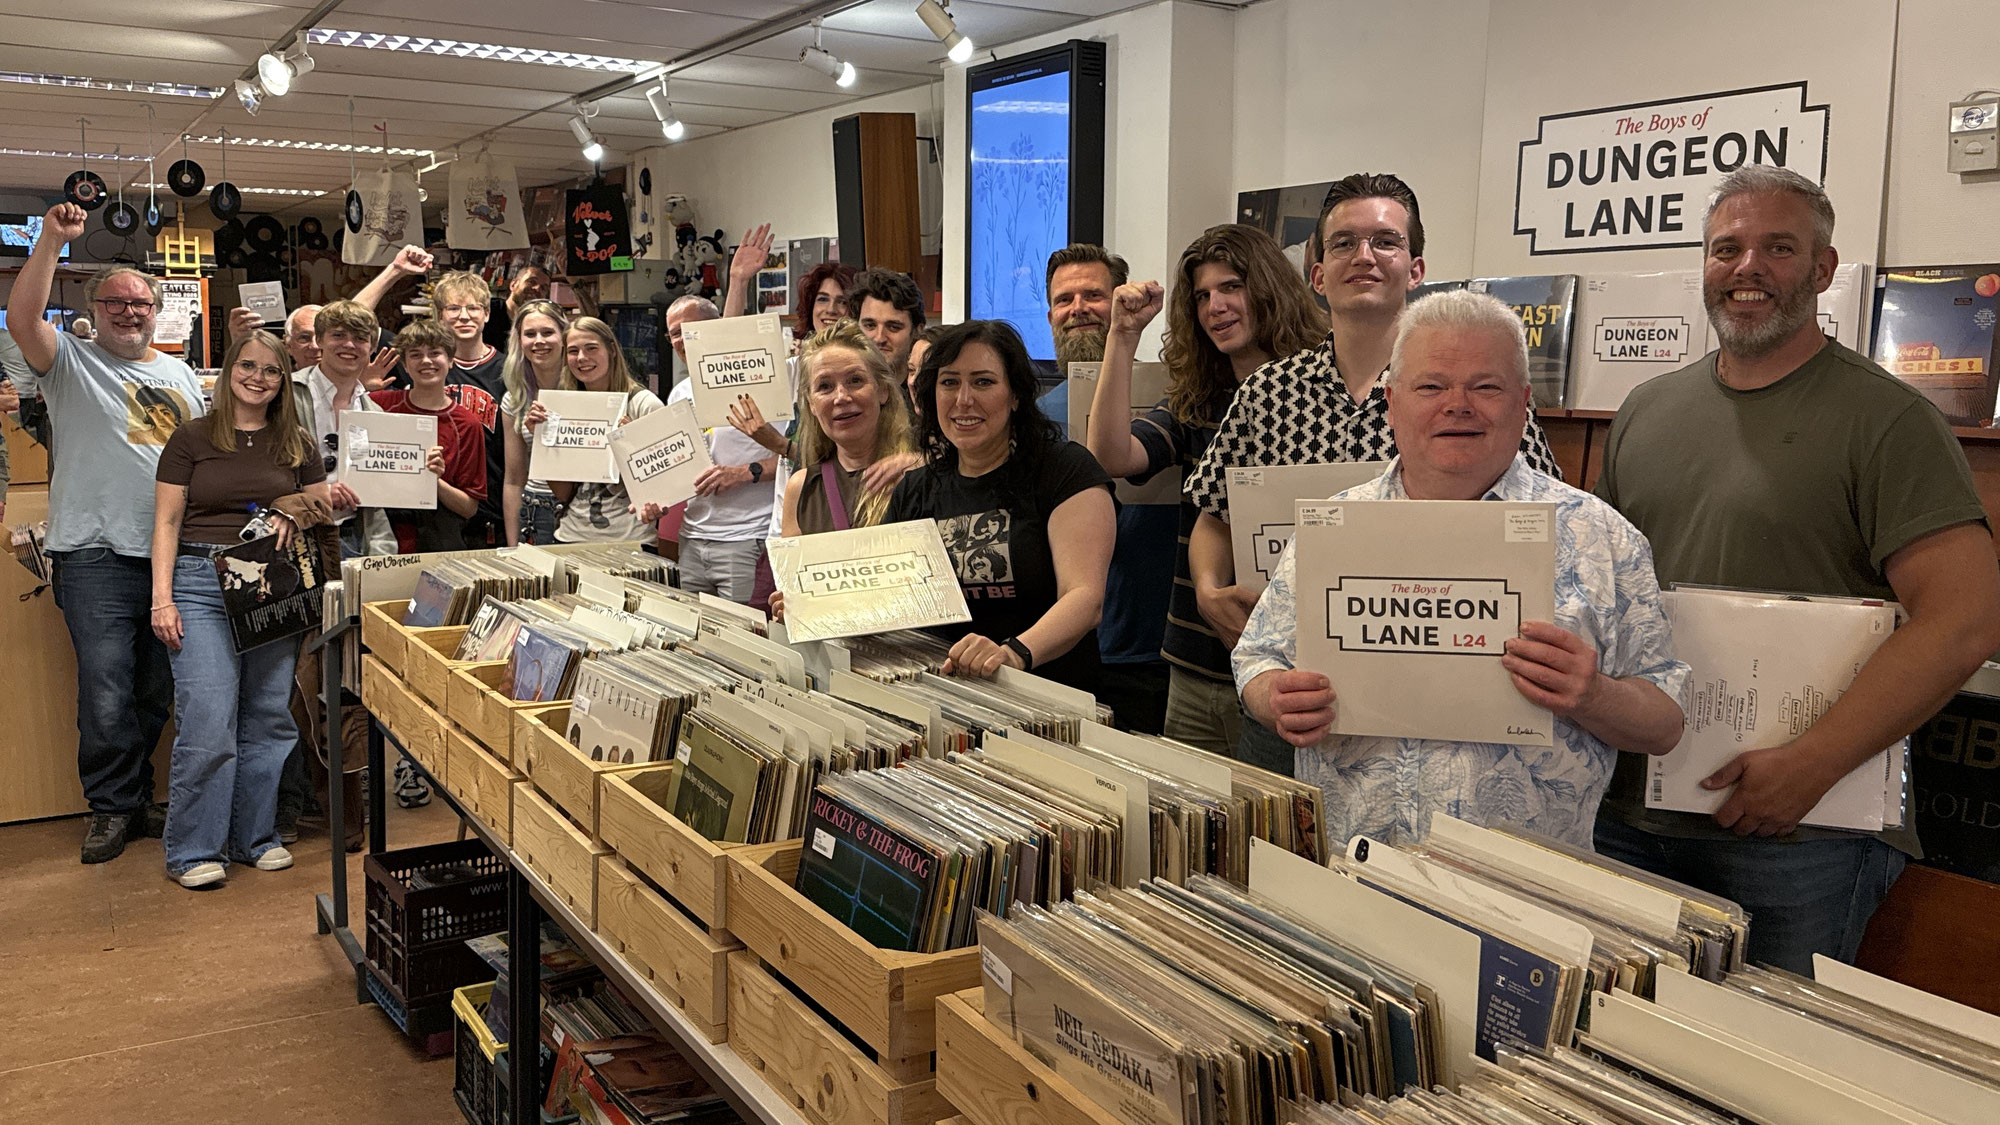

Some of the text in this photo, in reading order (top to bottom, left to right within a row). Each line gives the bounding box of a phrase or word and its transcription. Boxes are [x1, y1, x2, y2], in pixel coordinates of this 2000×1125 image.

[1615, 106, 1713, 136] The Boys of
[1547, 127, 1788, 189] DUNGEON
[1565, 193, 1683, 238] LANE
[162, 284, 198, 292] EATLES
[1604, 328, 1679, 342] DUNGEON
[1610, 345, 1671, 358] LANE L24
[707, 358, 766, 373] DUNGEON
[715, 373, 746, 385] LANE
[558, 426, 606, 436] UNGEON
[556, 437, 584, 446] LANE
[368, 450, 418, 460] UNGEON
[635, 439, 686, 469] DUNGEON
[365, 460, 396, 470] LANE
[643, 454, 686, 477] LANE L24
[812, 560, 915, 582] DUNGEON
[825, 576, 911, 592] LANE L24
[986, 585, 1016, 598] BE
[1391, 583, 1453, 595] The Boys of
[1347, 597, 1499, 620] DUNGEON
[1361, 624, 1486, 647] LANE L24
[579, 672, 655, 724] PRETENDERS
[813, 796, 858, 834] RICKEY
[856, 821, 867, 841] &
[867, 826, 895, 857] THE
[892, 841, 931, 879] FROG
[1053, 1003, 1155, 1096] NEIL SEDAKA
[1055, 1032, 1078, 1057] Sings
[1080, 1049, 1094, 1069] His
[1096, 1063, 1134, 1098] Greatest
